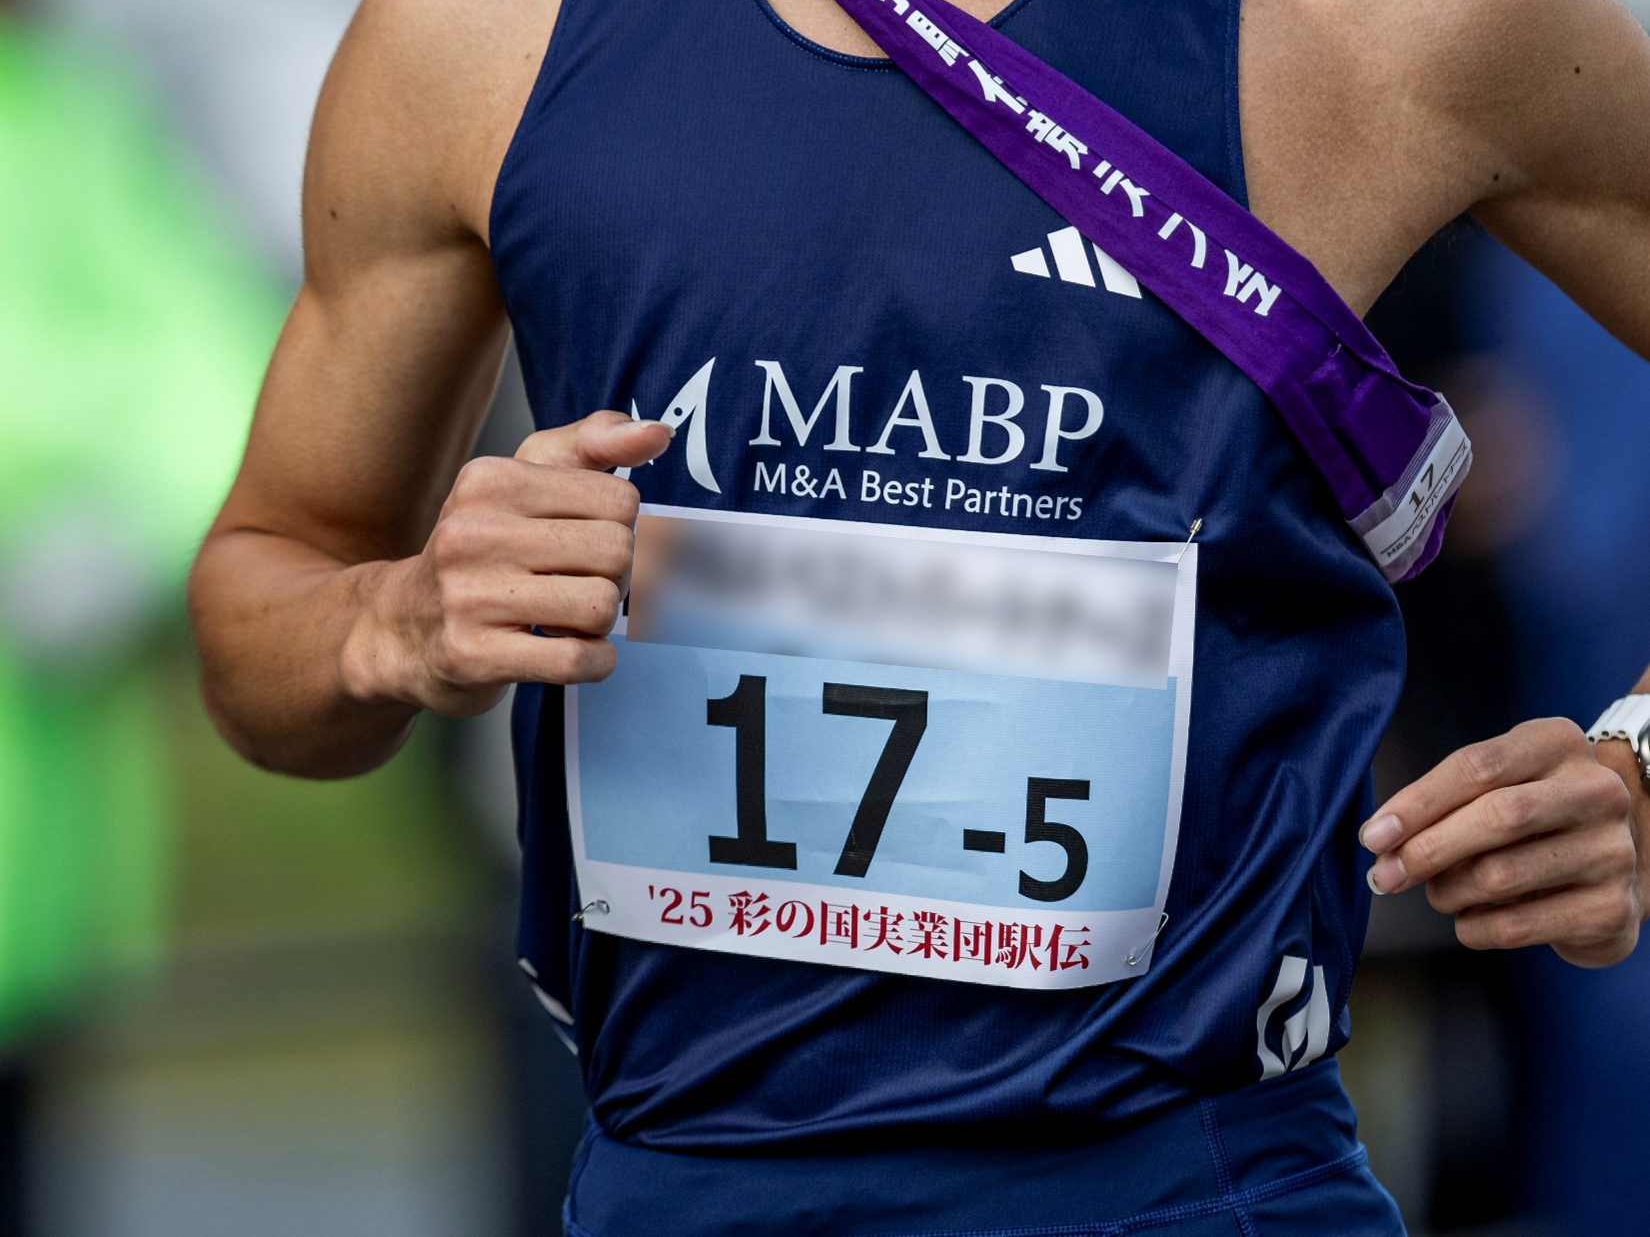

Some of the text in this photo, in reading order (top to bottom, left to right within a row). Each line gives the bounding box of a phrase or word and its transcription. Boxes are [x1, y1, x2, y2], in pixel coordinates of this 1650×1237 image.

[748, 359, 1104, 473] MABP
[753, 461, 1083, 520] M&A Best Partners
[648, 885, 1091, 972] '25 彩の国実業団駅伝
